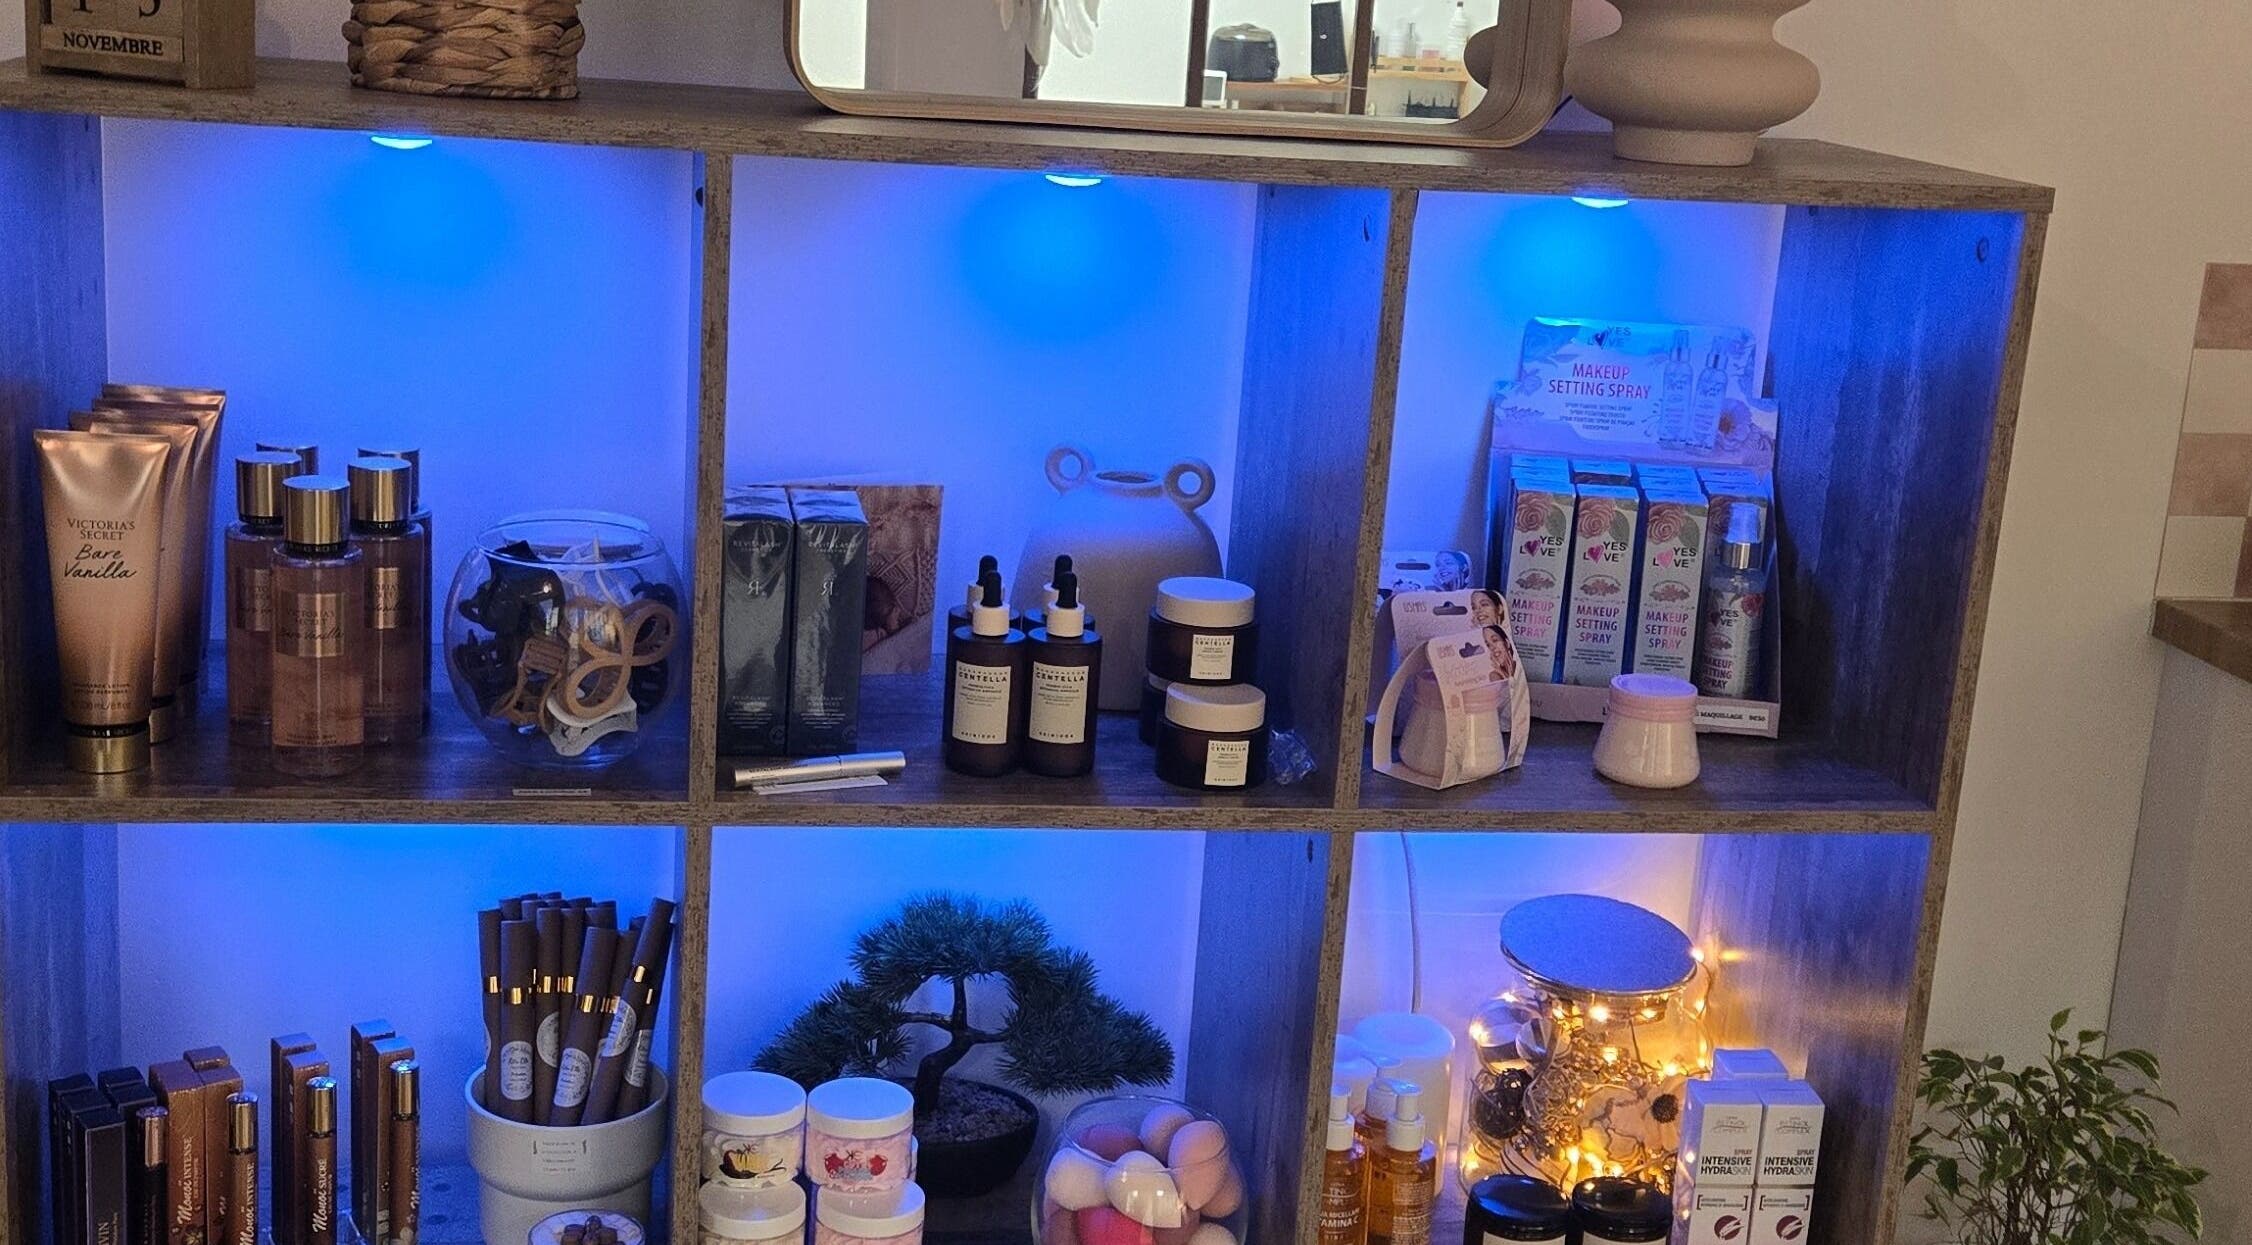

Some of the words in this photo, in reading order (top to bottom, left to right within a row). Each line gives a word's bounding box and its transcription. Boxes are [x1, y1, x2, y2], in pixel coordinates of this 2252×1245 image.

[63, 32, 164, 56] NOVEMBRE
[1572, 363, 1630, 378] MAKEUP
[1549, 380, 1604, 398] SETTING
[1608, 384, 1651, 400] SPRAY
[68, 518, 136, 530] VICTORIA'S
[80, 530, 124, 541] SECRET
[1540, 536, 1563, 546] YES
[75, 543, 123, 561] Bare
[1603, 542, 1626, 552] YES
[1674, 547, 1696, 557] YES
[64, 561, 136, 579] Vanilla
[1512, 599, 1554, 612] MAKEUP
[1576, 605, 1620, 618] MAKEUP
[1510, 612, 1552, 625] SETTING
[1646, 611, 1688, 624] MAKEUP
[1720, 608, 1739, 618] YES
[1514, 625, 1546, 638] SPRAY
[1576, 618, 1618, 632] SETTING
[1645, 624, 1687, 637] SETTING
[1579, 632, 1612, 645] SPRAY
[1648, 638, 1681, 650] SPRAY
[959, 672, 1007, 682] CENTELLA
[1036, 672, 1084, 682] CENTELLA
[184, 1135, 193, 1179] INTENSE
[1701, 1156, 1752, 1166] INTENSIVE
[1764, 1156, 1814, 1166] INTENSIVE
[1700, 1166, 1752, 1175] HYDRASKIN
[1764, 1166, 1814, 1176] HYDRASKIN
[246, 1162, 254, 1205] INTENSE
[1320, 1216, 1352, 1228] AMINA
